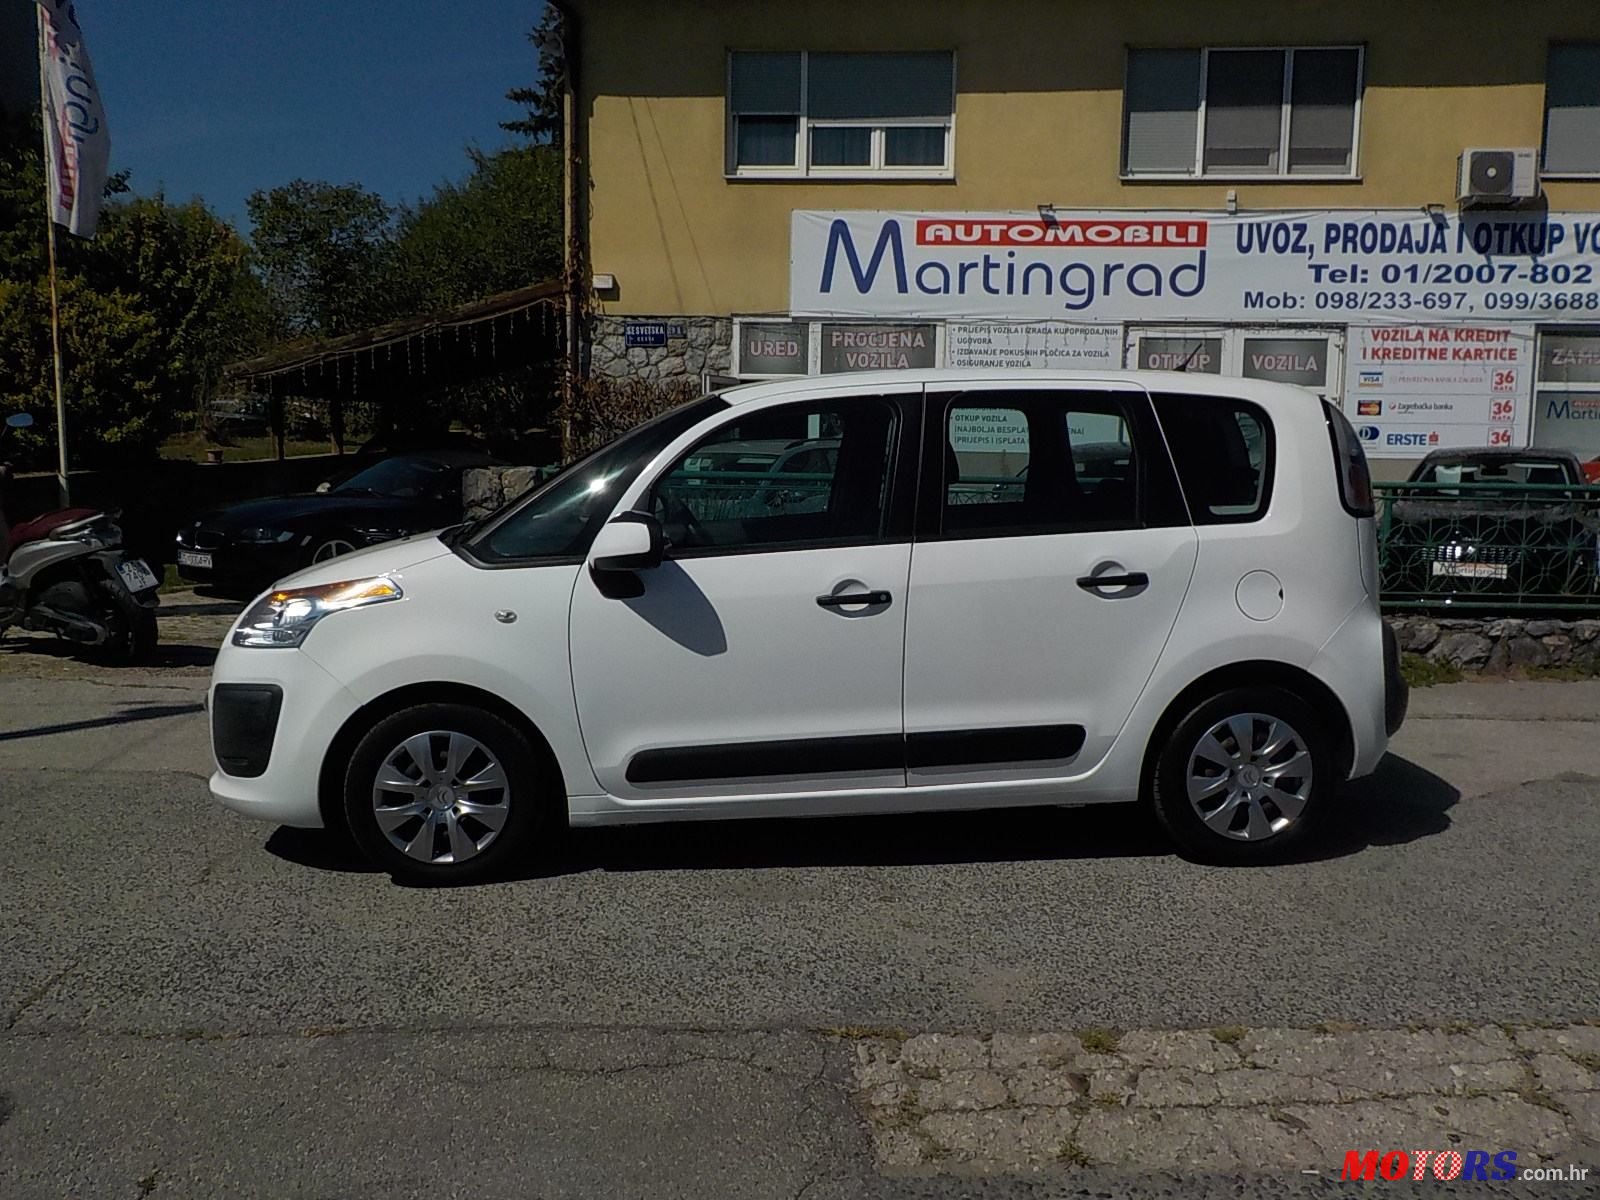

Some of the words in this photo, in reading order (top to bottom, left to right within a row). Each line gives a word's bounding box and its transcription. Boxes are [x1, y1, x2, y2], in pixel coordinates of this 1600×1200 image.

[925, 224, 1199, 243] AUTOMOBILI
[1236, 223, 1315, 260] UVOZ,
[1324, 223, 1448, 254] PRODAJA
[1456, 223, 1465, 254] I
[1474, 222, 1565, 255] OTKUP
[819, 219, 1207, 310] Martingrad
[1308, 264, 1369, 284] Tel:
[1381, 264, 1593, 284] 01/2007-802
[1244, 291, 1306, 309] Mob:
[1315, 291, 1475, 313] 098/233-697,
[1484, 292, 1599, 310] 099/3688
[993, 327, 1019, 335] VOZILA
[1054, 327, 1118, 336] KUPOPRODAJNIH
[1371, 329, 1424, 342] VOZILA
[1429, 330, 1450, 342] NA
[1454, 329, 1511, 342] KREDIT
[831, 331, 926, 349] PROCJENA
[957, 337, 992, 345] UGOVORA
[750, 340, 799, 357] URED
[956, 348, 998, 356] IZDAVANJE
[1000, 349, 1038, 357] POKUSNIH
[1072, 350, 1081, 358] ZA
[1083, 350, 1109, 358] VOZILA
[1362, 347, 1367, 360] I
[1371, 347, 1448, 360] KREDITNE
[1452, 347, 1518, 360] KARTICE
[846, 352, 910, 369] VOZILA
[956, 359, 1004, 367] OSIGURANJE
[1005, 360, 1031, 368] VOZILA
[1149, 354, 1211, 370] OTKUP
[1252, 354, 1318, 371] VOZILA
[1494, 370, 1514, 386] 36
[1434, 402, 1453, 410] banka
[1493, 400, 1513, 415] 36
[1386, 433, 1427, 446] ERSTE
[1490, 430, 1511, 444] 36
